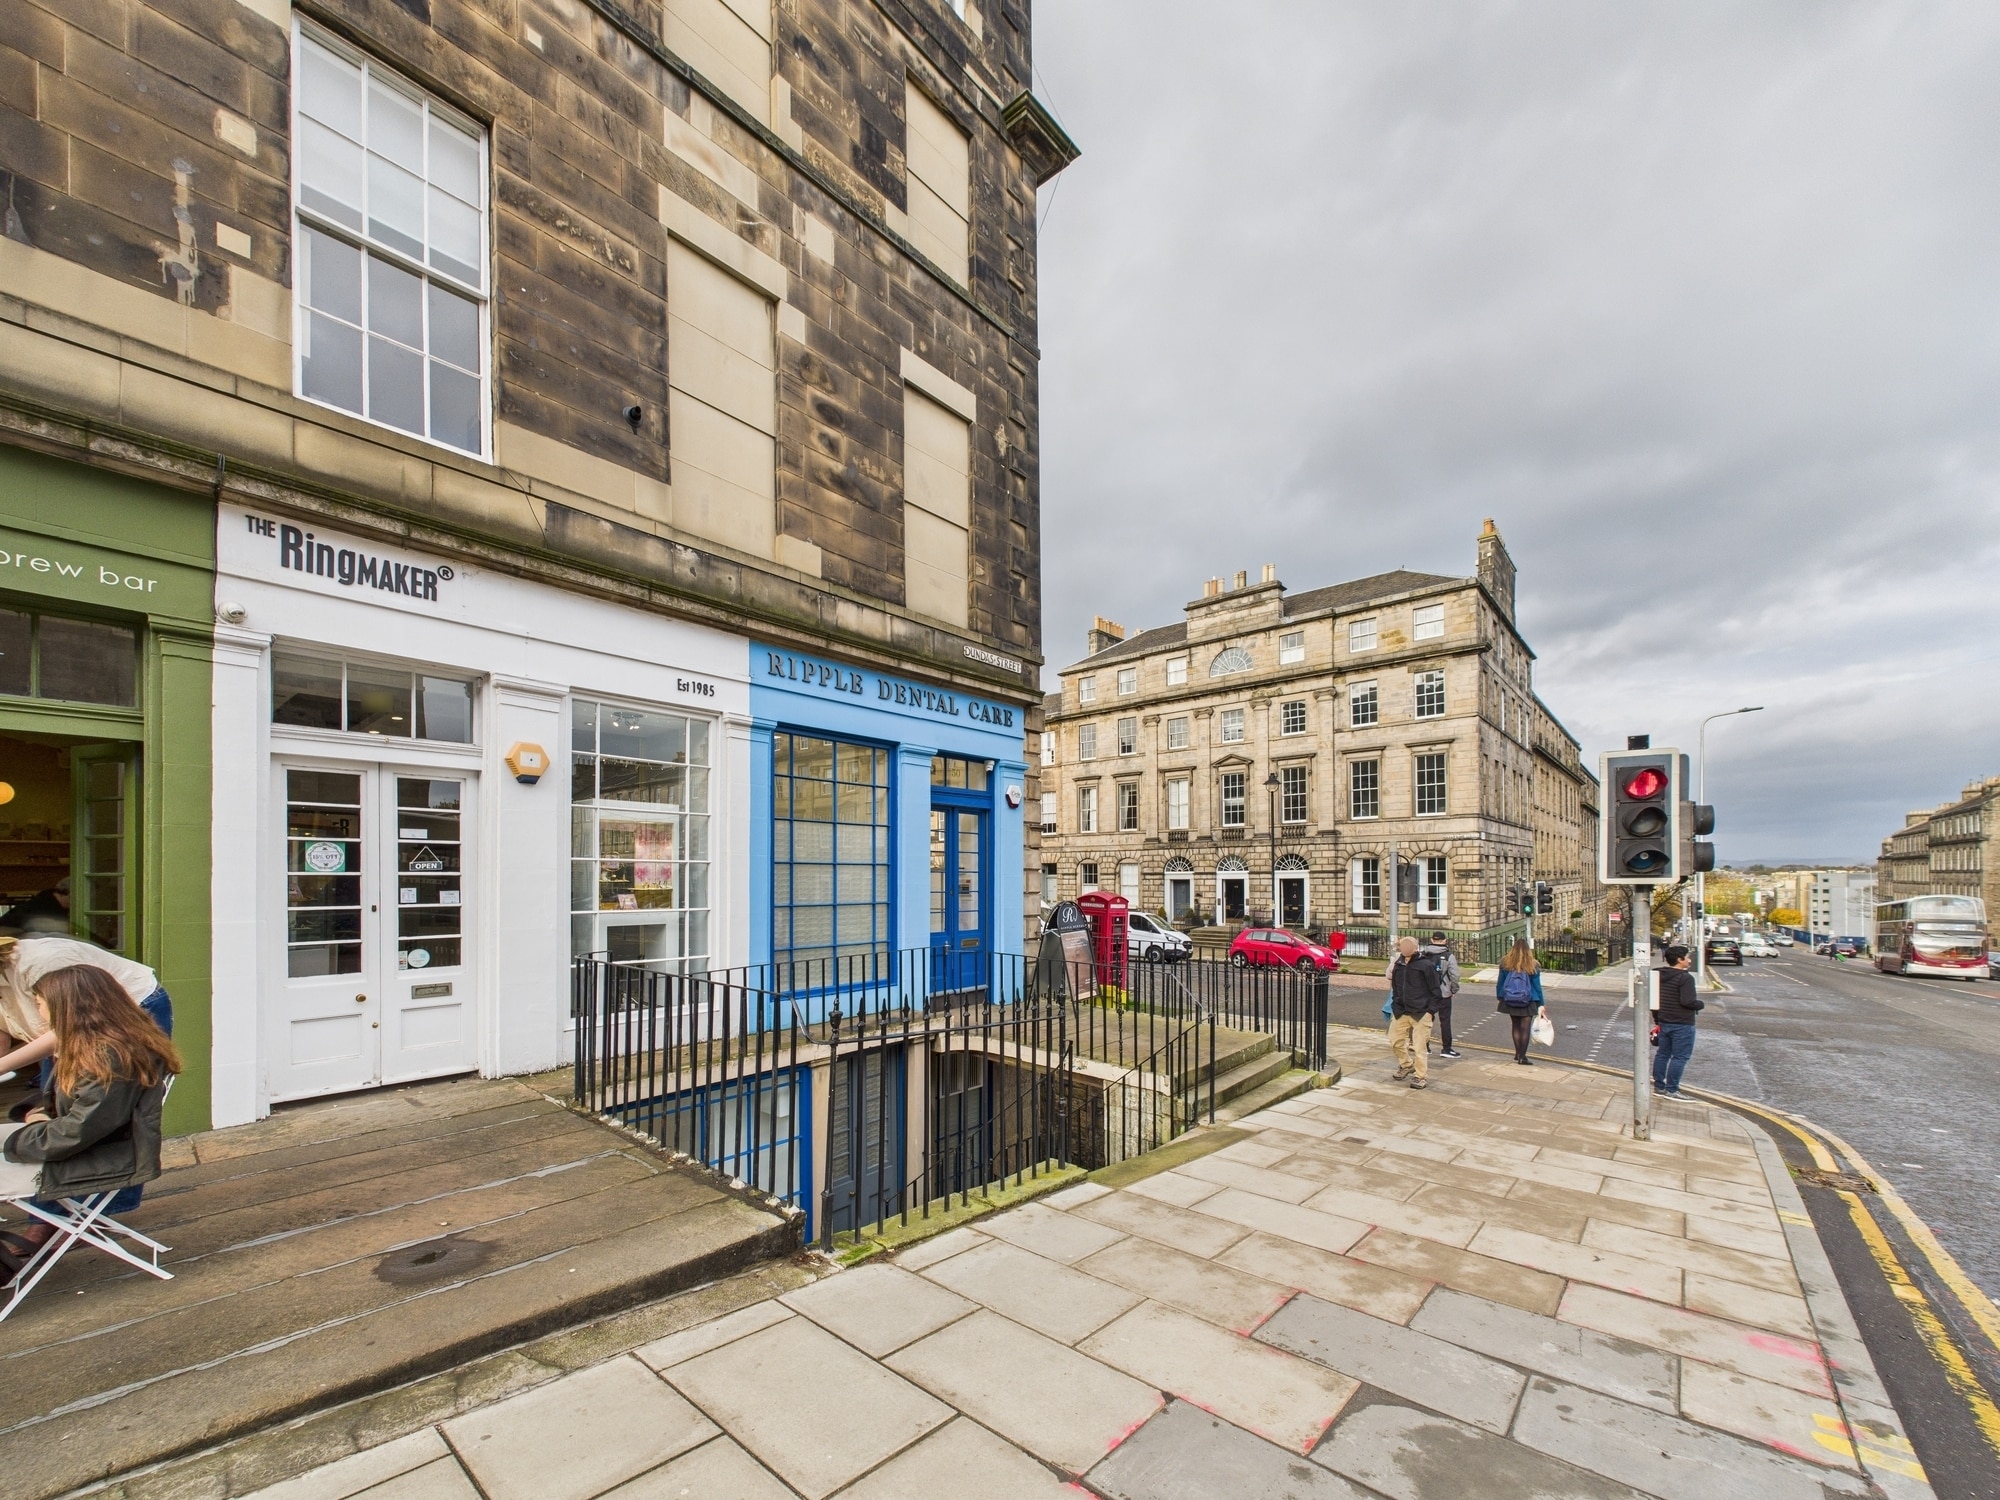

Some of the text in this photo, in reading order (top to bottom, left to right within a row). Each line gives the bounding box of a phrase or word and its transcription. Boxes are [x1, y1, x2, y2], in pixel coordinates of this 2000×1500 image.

[245, 515, 276, 538] THE
[99, 565, 158, 592] bar
[964, 646, 1021, 673] DUNDAS STREET
[677, 678, 715, 697] Est 1985
[767, 651, 1013, 728] RIPPLE DENTAL CARE
